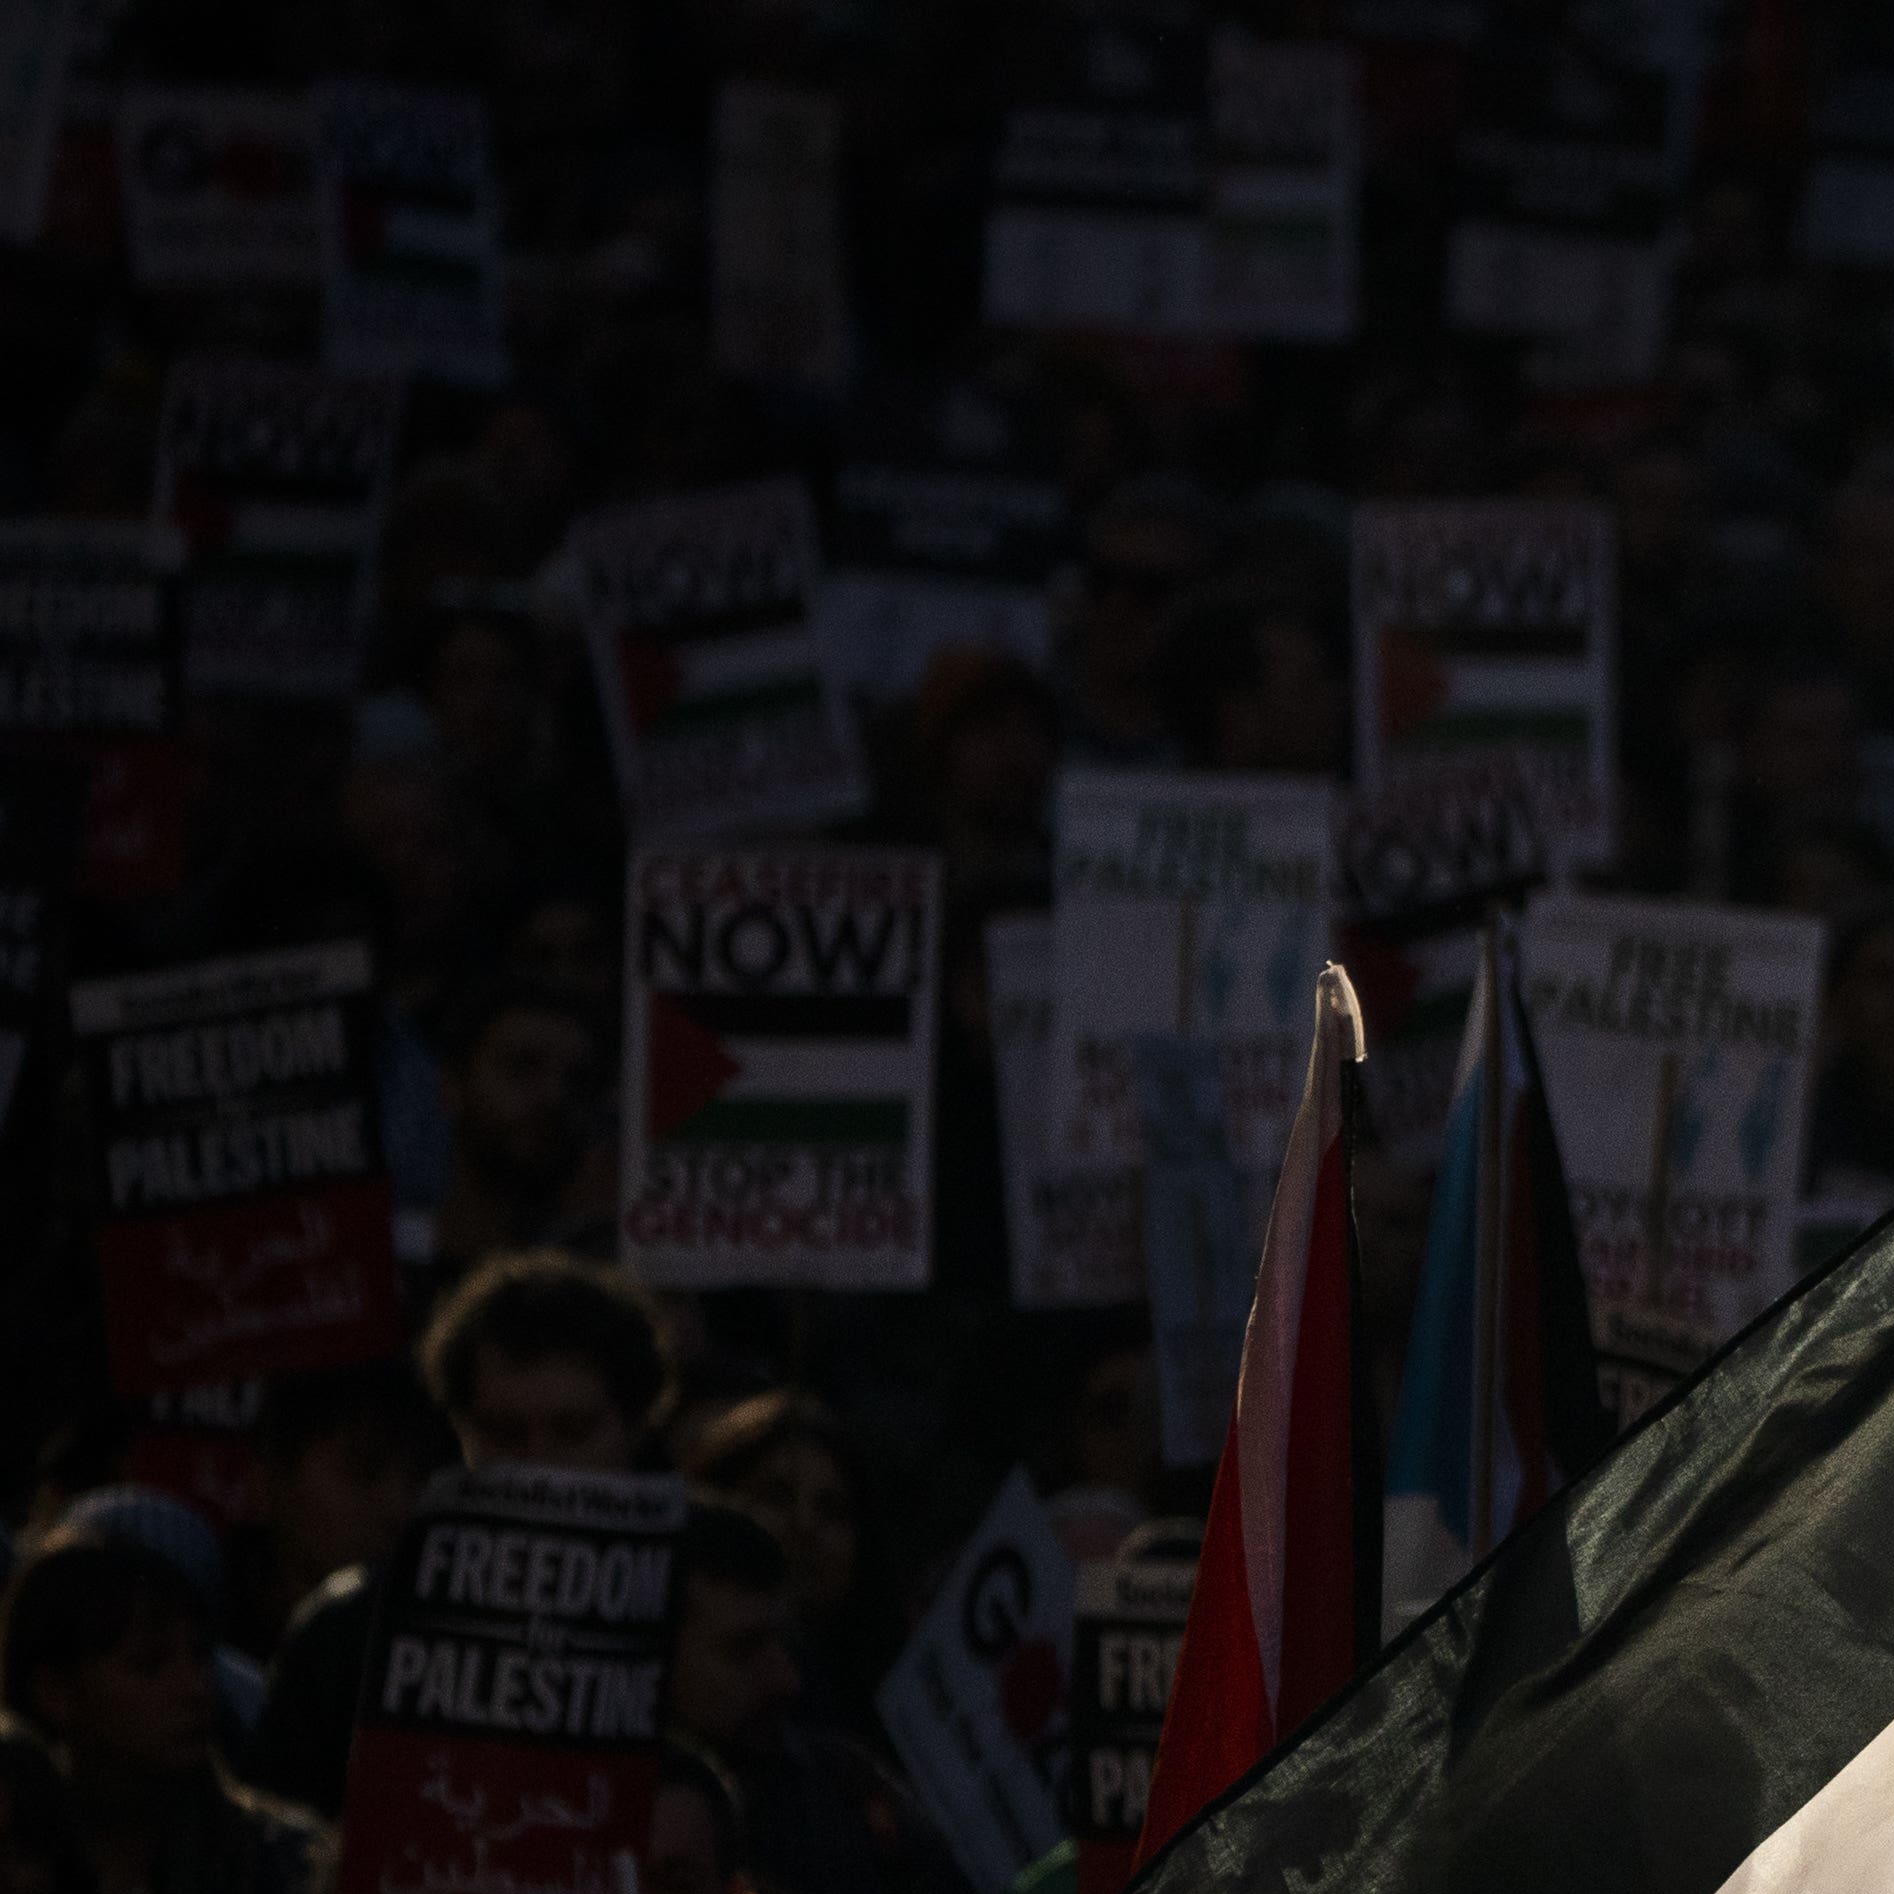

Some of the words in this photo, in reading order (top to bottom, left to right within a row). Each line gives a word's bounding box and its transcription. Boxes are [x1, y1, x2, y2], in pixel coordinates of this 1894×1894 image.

[639, 901, 924, 993] NOW!
[107, 1004, 348, 1110] FREEDOM
[105, 1100, 368, 1210] PALESTINE
[413, 1522, 673, 1625] FREEDOM
[380, 1632, 665, 1741] PALESTINE
